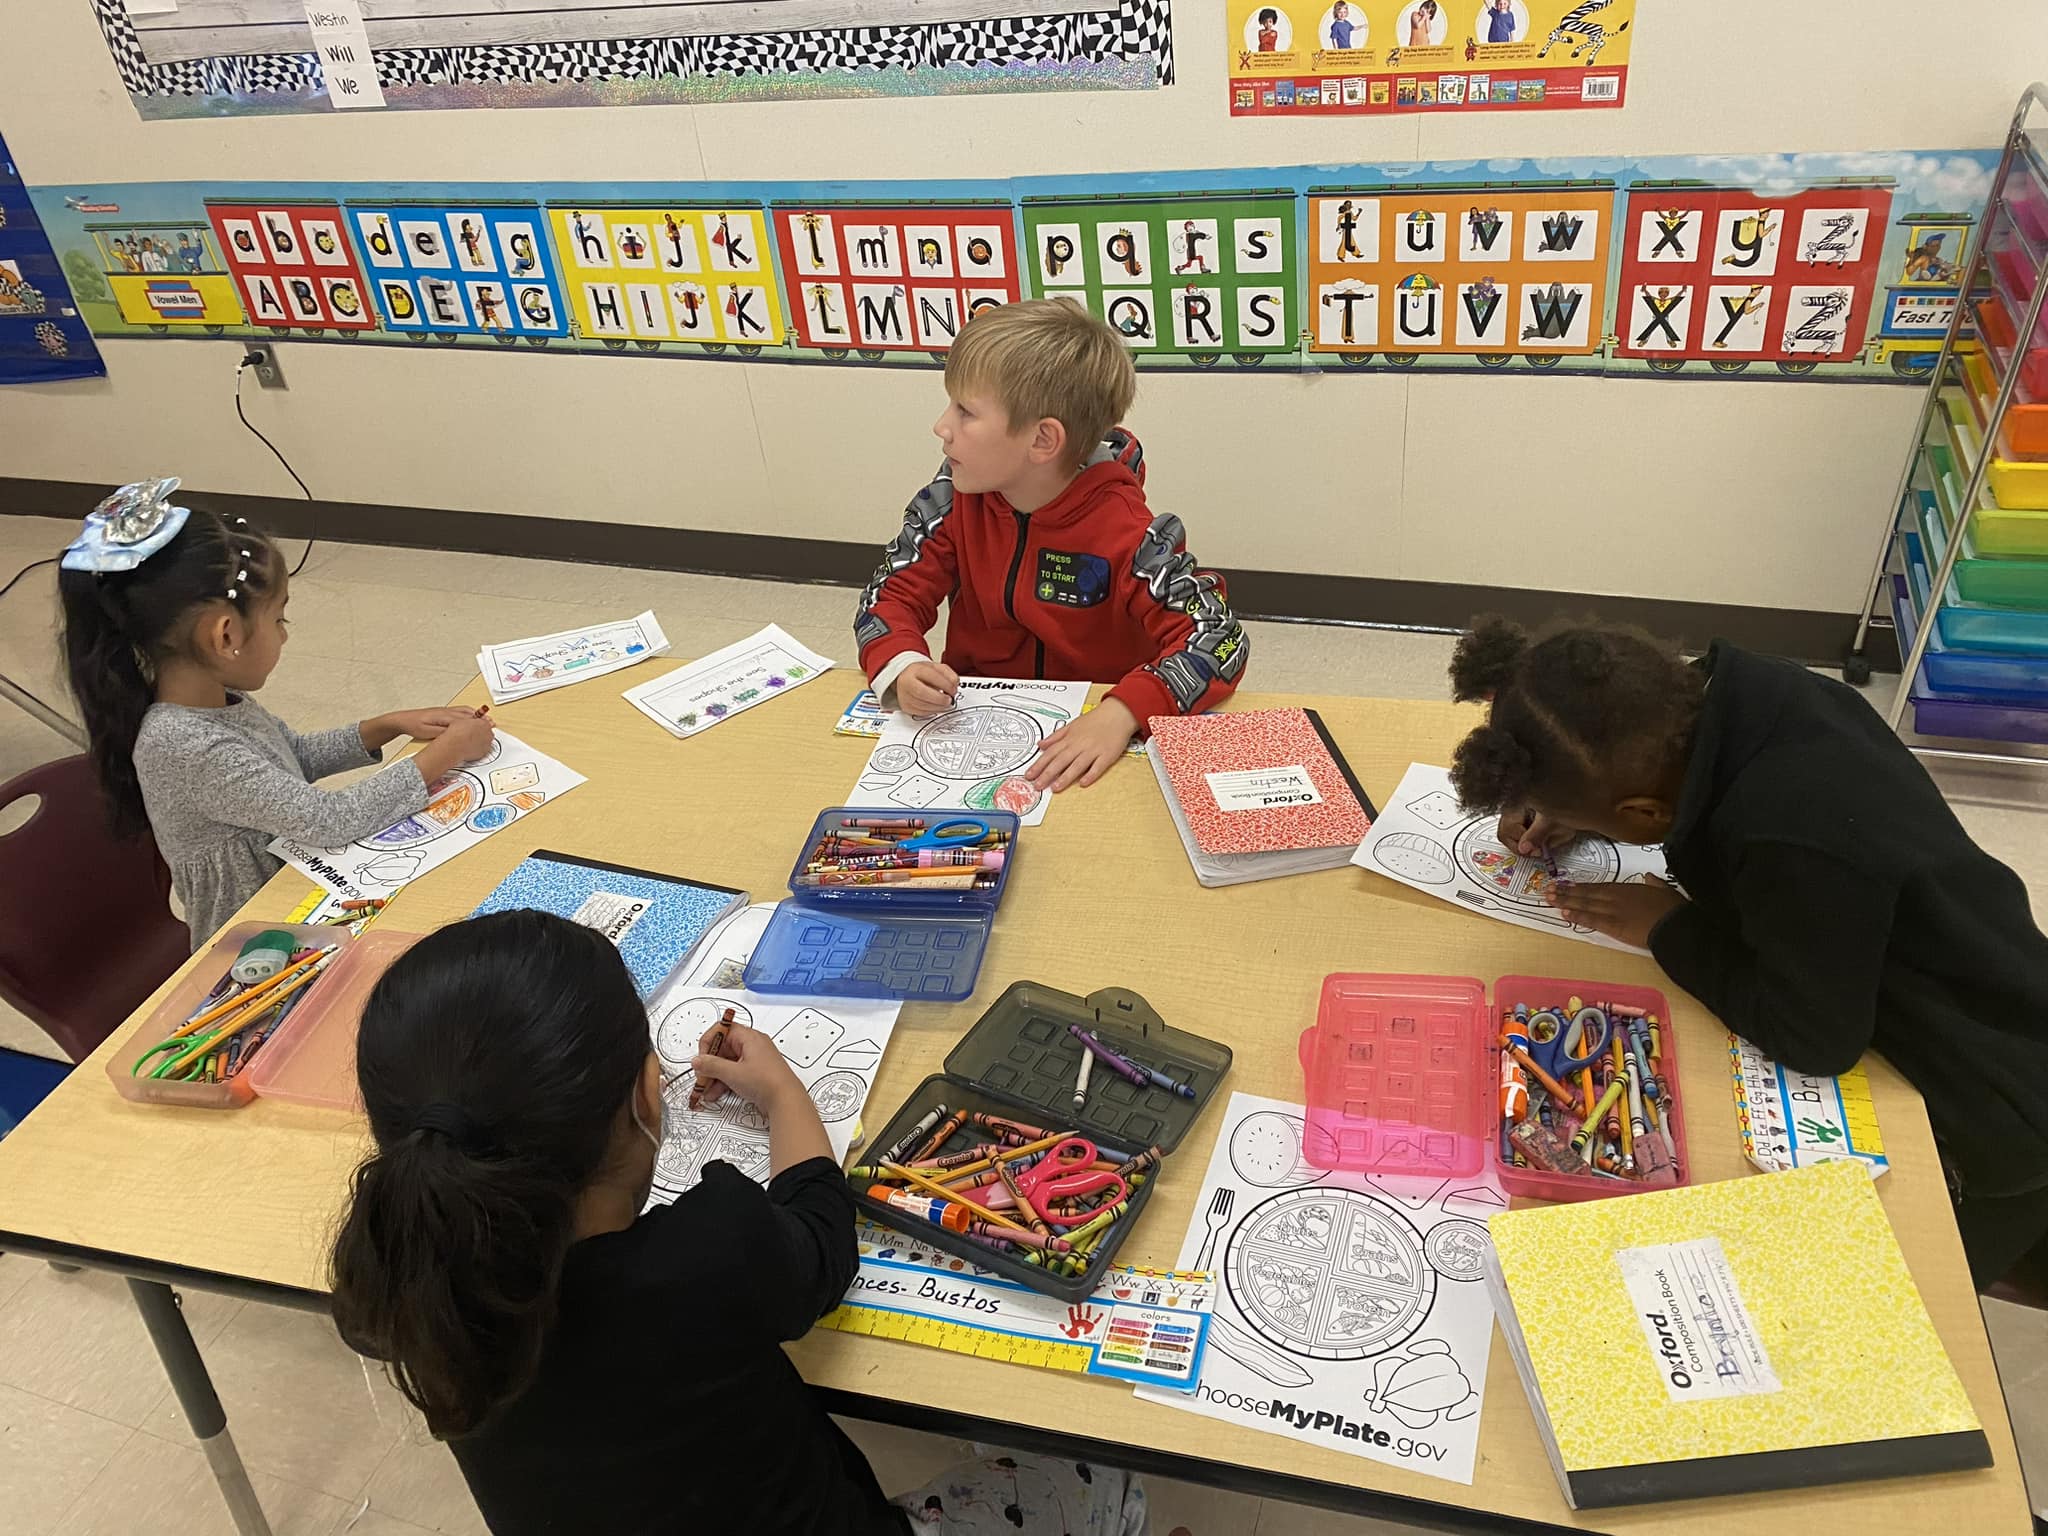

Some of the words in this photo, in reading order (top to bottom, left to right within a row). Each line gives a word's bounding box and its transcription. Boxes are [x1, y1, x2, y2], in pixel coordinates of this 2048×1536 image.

[308, 12, 349, 28] Westin
[325, 45, 355, 63] Will
[334, 76, 359, 95] We
[234, 229, 255, 253] a
[265, 216, 293, 254] b
[370, 217, 392, 256] d
[415, 231, 435, 256] e
[576, 218, 606, 261] h
[721, 220, 752, 267] k
[1407, 222, 1434, 252] u
[1473, 221, 1504, 252] v
[1542, 220, 1584, 251] w
[1651, 220, 1688, 253] x
[1730, 220, 1764, 268] y
[1816, 216, 1854, 251] z
[858, 237, 889, 268] m
[917, 238, 943, 265] n
[967, 237, 993, 266] o
[1046, 234, 1074, 277] p
[1106, 233, 1138, 277] q
[1243, 230, 1272, 260] s
[154, 295, 179, 304] Vowel
[179, 295, 198, 304] Men
[259, 279, 283, 314] A
[291, 279, 318, 316] B
[329, 283, 360, 318] C
[384, 284, 415, 320] D
[430, 284, 455, 322] E
[475, 286, 497, 322] F
[520, 287, 552, 324] G
[590, 287, 622, 329] H
[733, 289, 765, 336] K
[818, 293, 843, 335] L
[863, 295, 904, 340] M
[920, 296, 956, 338] N
[1107, 295, 1151, 340] Q
[1183, 294, 1217, 341] R
[1247, 294, 1279, 338] S
[1332, 292, 1365, 340] T
[1461, 292, 1503, 338] V
[1529, 292, 1584, 339] W
[1636, 295, 1686, 343] X
[1713, 295, 1756, 346] Y
[1795, 292, 1847, 341] Z
[1894, 310, 1936, 324] Fast
[1045, 553, 1072, 564] PRESS
[1055, 564, 1062, 572] A
[1041, 569, 1051, 579] TO
[1052, 572, 1076, 583] START
[689, 684, 728, 702] Shapes
[958, 681, 1068, 692] ChooseMyPlat
[1250, 776, 1303, 788] Westin
[1252, 789, 1300, 797] Composition
[1263, 793, 1313, 806] Oxford
[281, 839, 366, 900] ChooseMyPlate.gov
[608, 903, 644, 940] Oxford
[1756, 1141, 1772, 1157] Dd
[879, 1233, 904, 1249] Mm
[1351, 1244, 1400, 1264] Grains
[1112, 1273, 1140, 1289] Ww
[1251, 1265, 1317, 1288] Vegetables
[1655, 1268, 1674, 1298] Book
[917, 1276, 1001, 1314] Bustos
[1337, 1297, 1391, 1318] Protein
[1140, 1309, 1171, 1322] colors
[1646, 1312, 1693, 1389] Oxford
[1668, 1299, 1704, 1374] Composition
[1183, 1379, 1448, 1462] hooseMyPlate.gov
